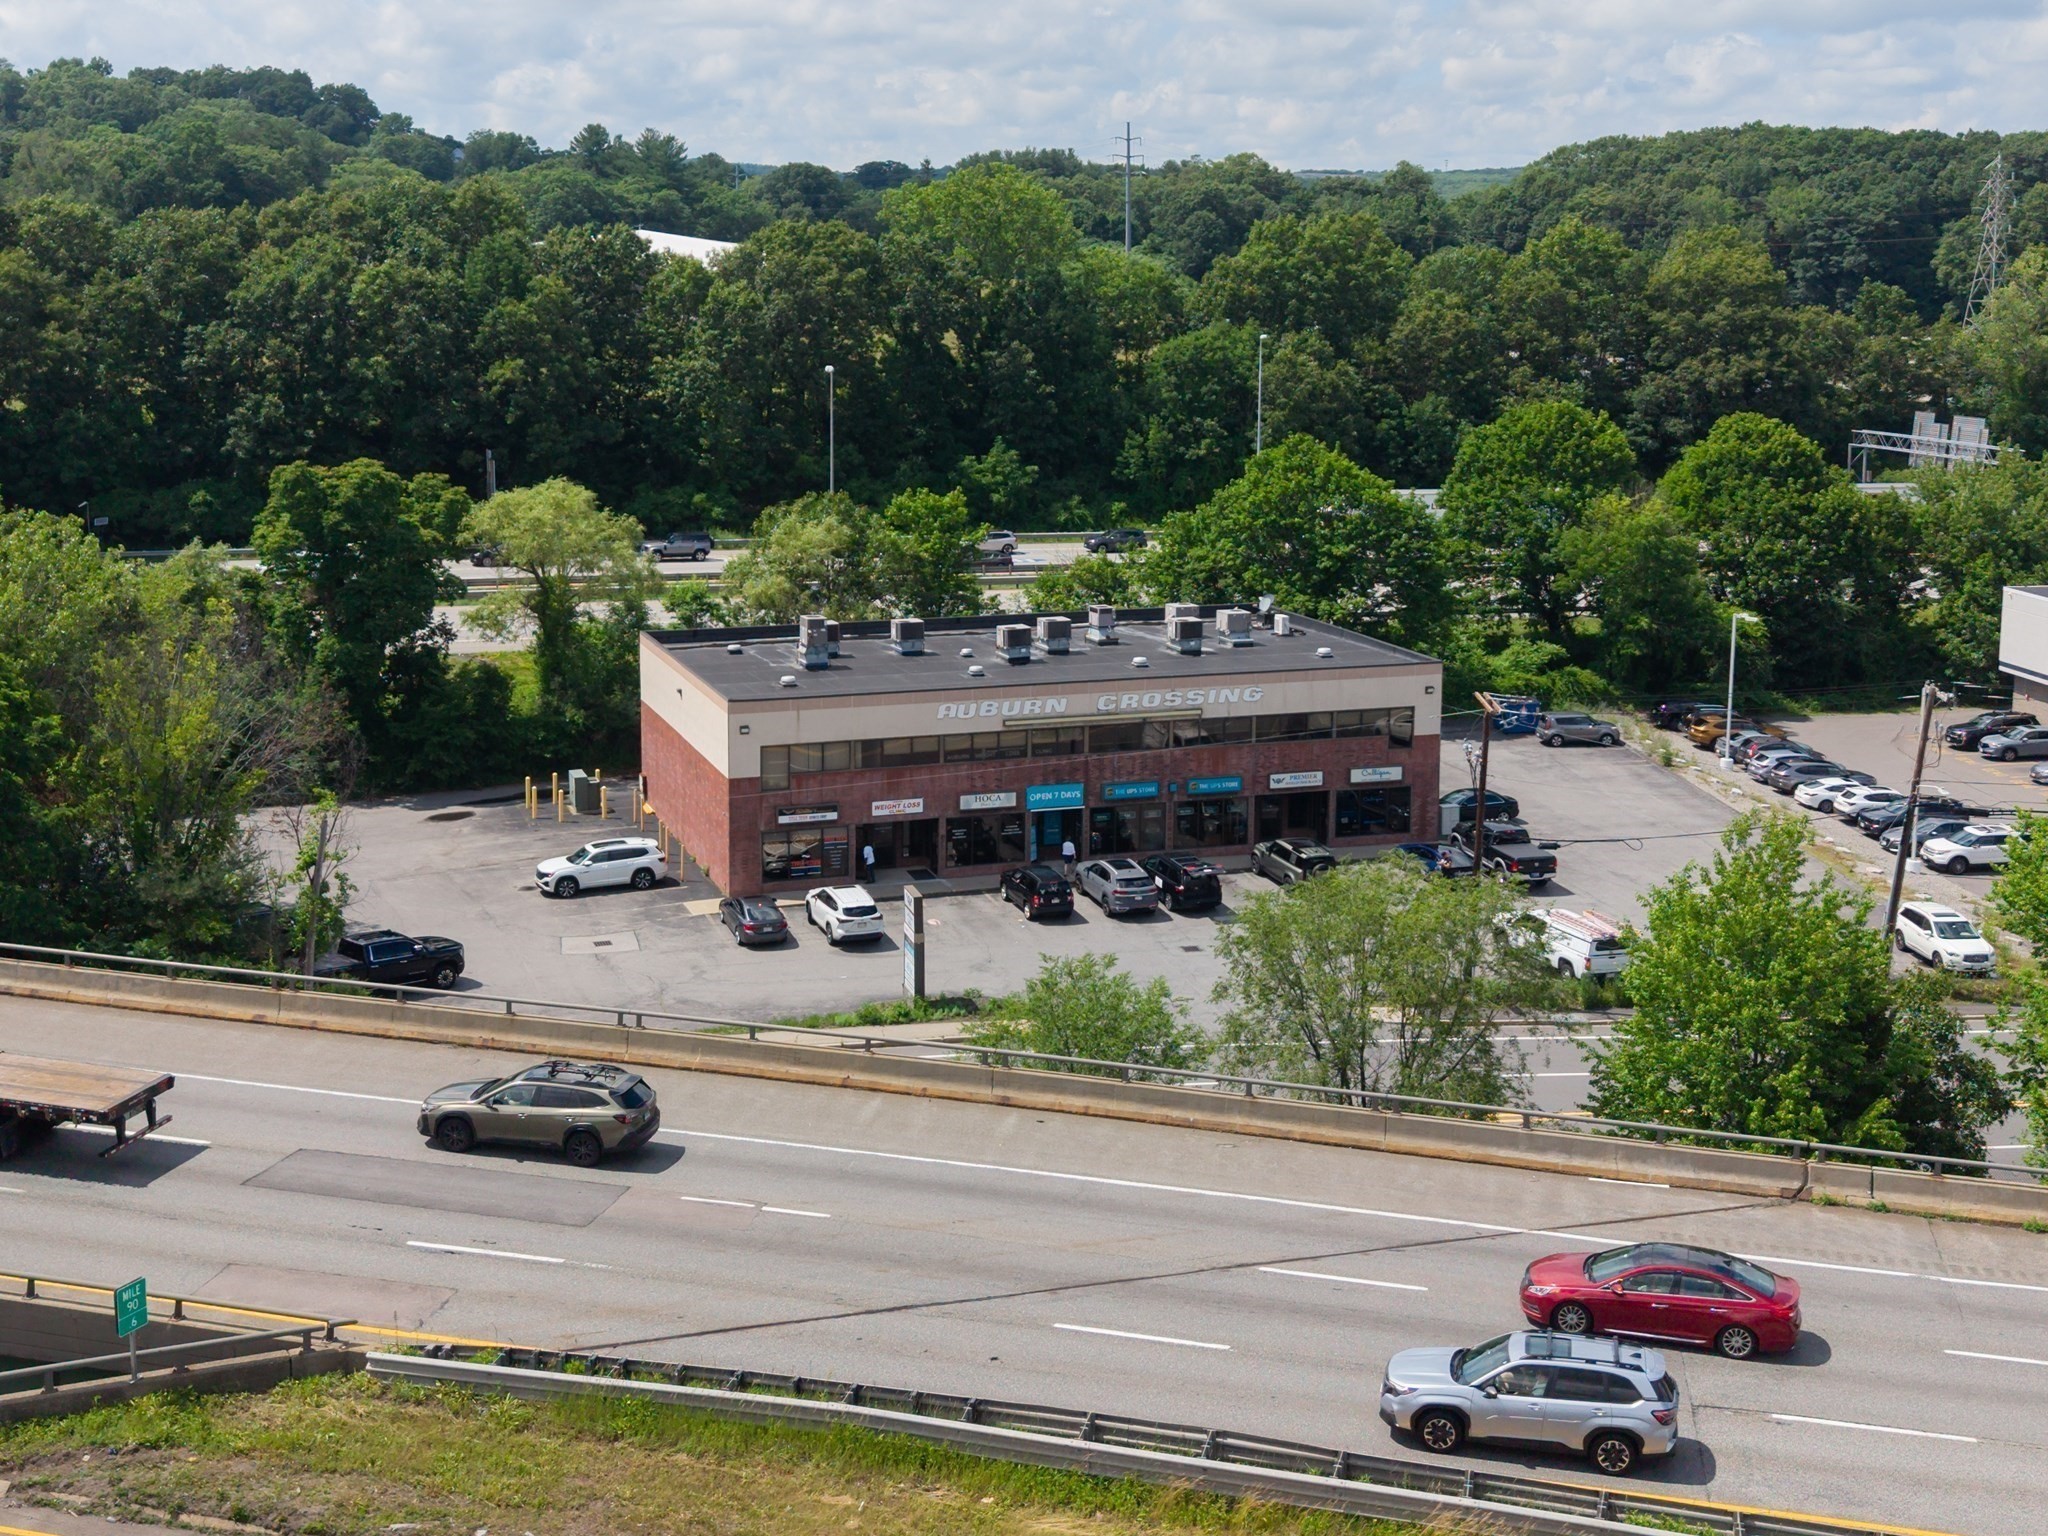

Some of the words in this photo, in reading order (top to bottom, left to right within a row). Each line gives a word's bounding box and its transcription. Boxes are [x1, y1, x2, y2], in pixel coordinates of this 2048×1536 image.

[937, 697, 1068, 720] AUBURN
[1097, 686, 1265, 712] CROSSING
[1289, 773, 1318, 781] PREMIER
[1361, 768, 1393, 779] Culligan
[974, 795, 1002, 803] HOCA
[1029, 792, 1053, 801] OPEN
[1053, 791, 1059, 799] 7
[1060, 790, 1081, 799] DAYS
[874, 803, 902, 812] WEIGHT
[902, 801, 921, 810] LOSS
[122, 1284, 141, 1302] MILE
[127, 1299, 139, 1312] 90
